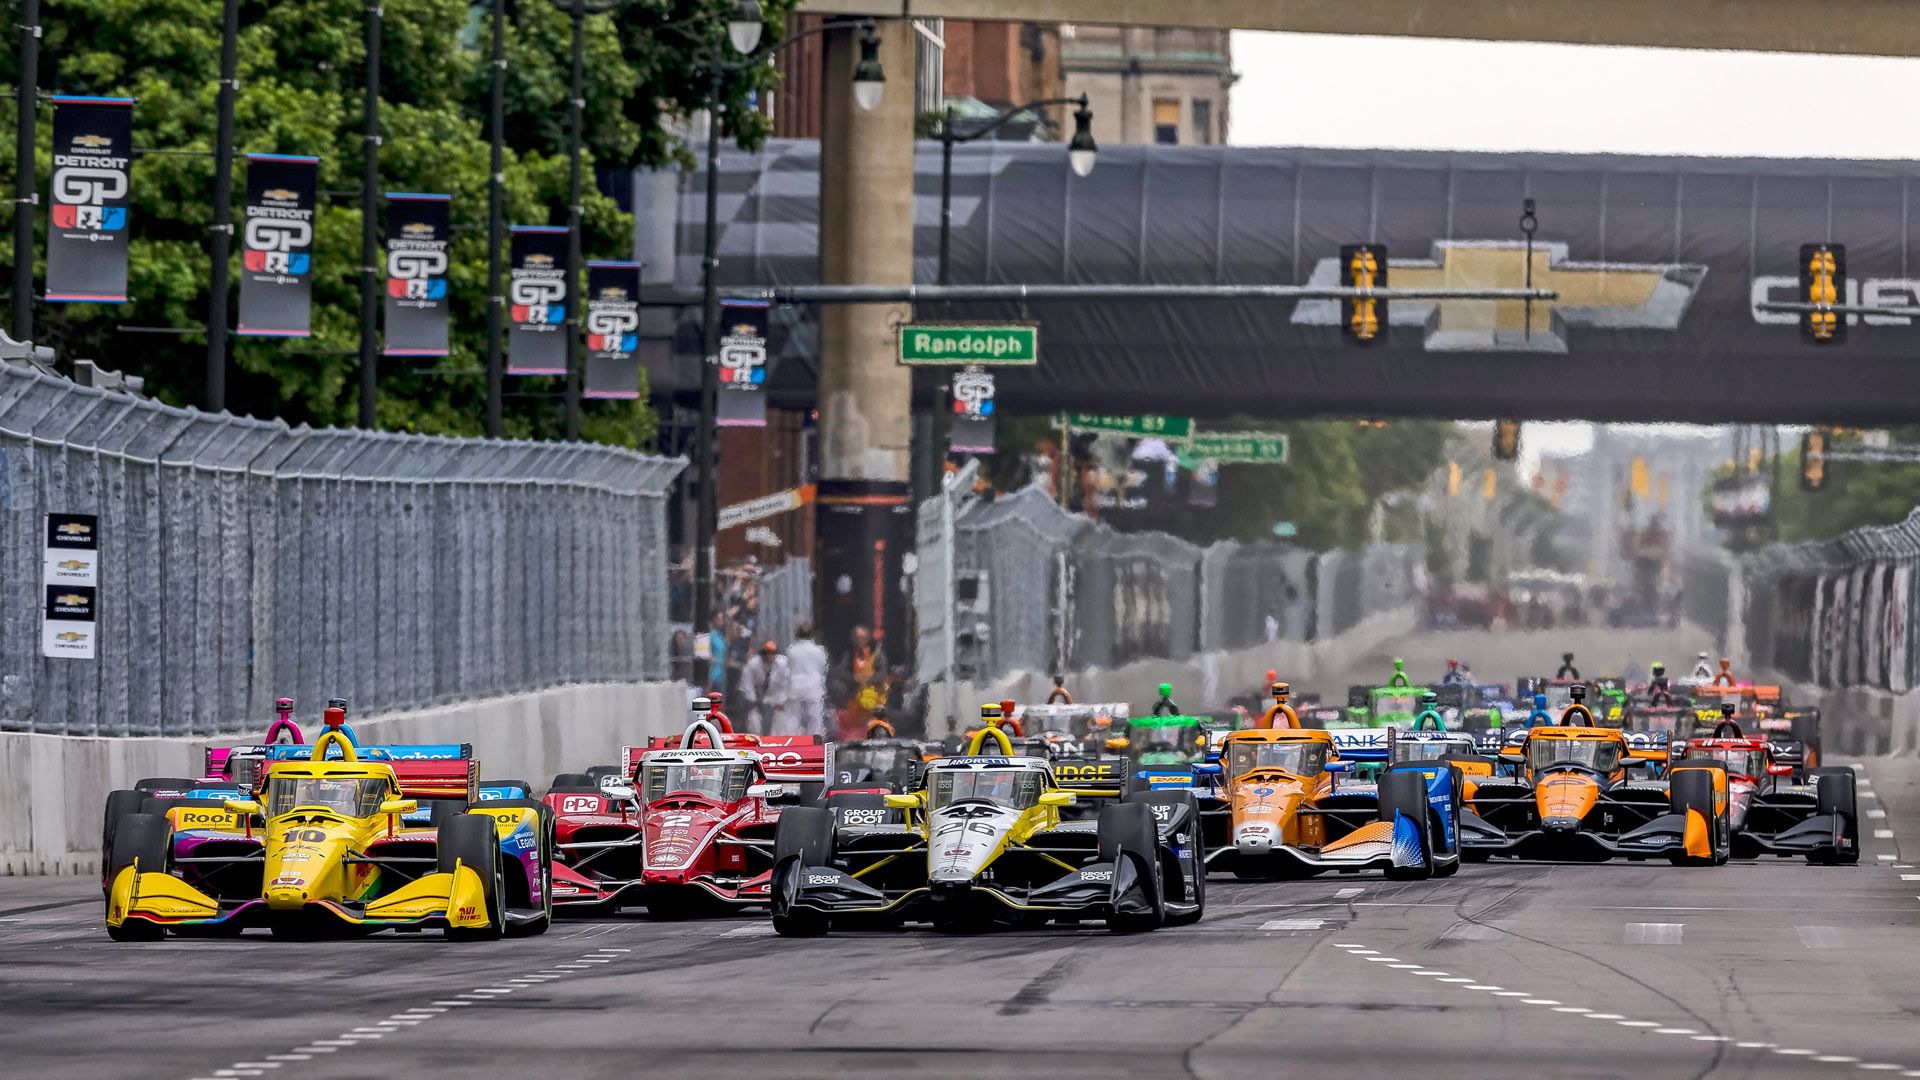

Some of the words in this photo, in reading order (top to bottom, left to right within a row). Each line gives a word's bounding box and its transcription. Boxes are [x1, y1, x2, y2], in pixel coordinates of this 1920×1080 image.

[55, 155, 128, 168] DETROIT
[54, 167, 128, 205] GP
[247, 206, 313, 219] DETROIT
[245, 217, 312, 252] GP
[388, 250, 448, 279] GP
[511, 279, 566, 305] GP
[588, 310, 639, 336] GP
[914, 333, 1022, 357] Randolph
[721, 345, 766, 368] GP
[658, 751, 722, 759] NEWGARDEN
[949, 757, 1008, 766] ANDRETTI
[1055, 765, 1112, 782] IDGE
[565, 798, 597, 811] PPG
[184, 814, 232, 823] Root
[662, 815, 692, 828] 2
[843, 816, 883, 824] 1001
[282, 829, 327, 843] 10
[936, 822, 997, 837] 26
[516, 837, 537, 850] LEGION
